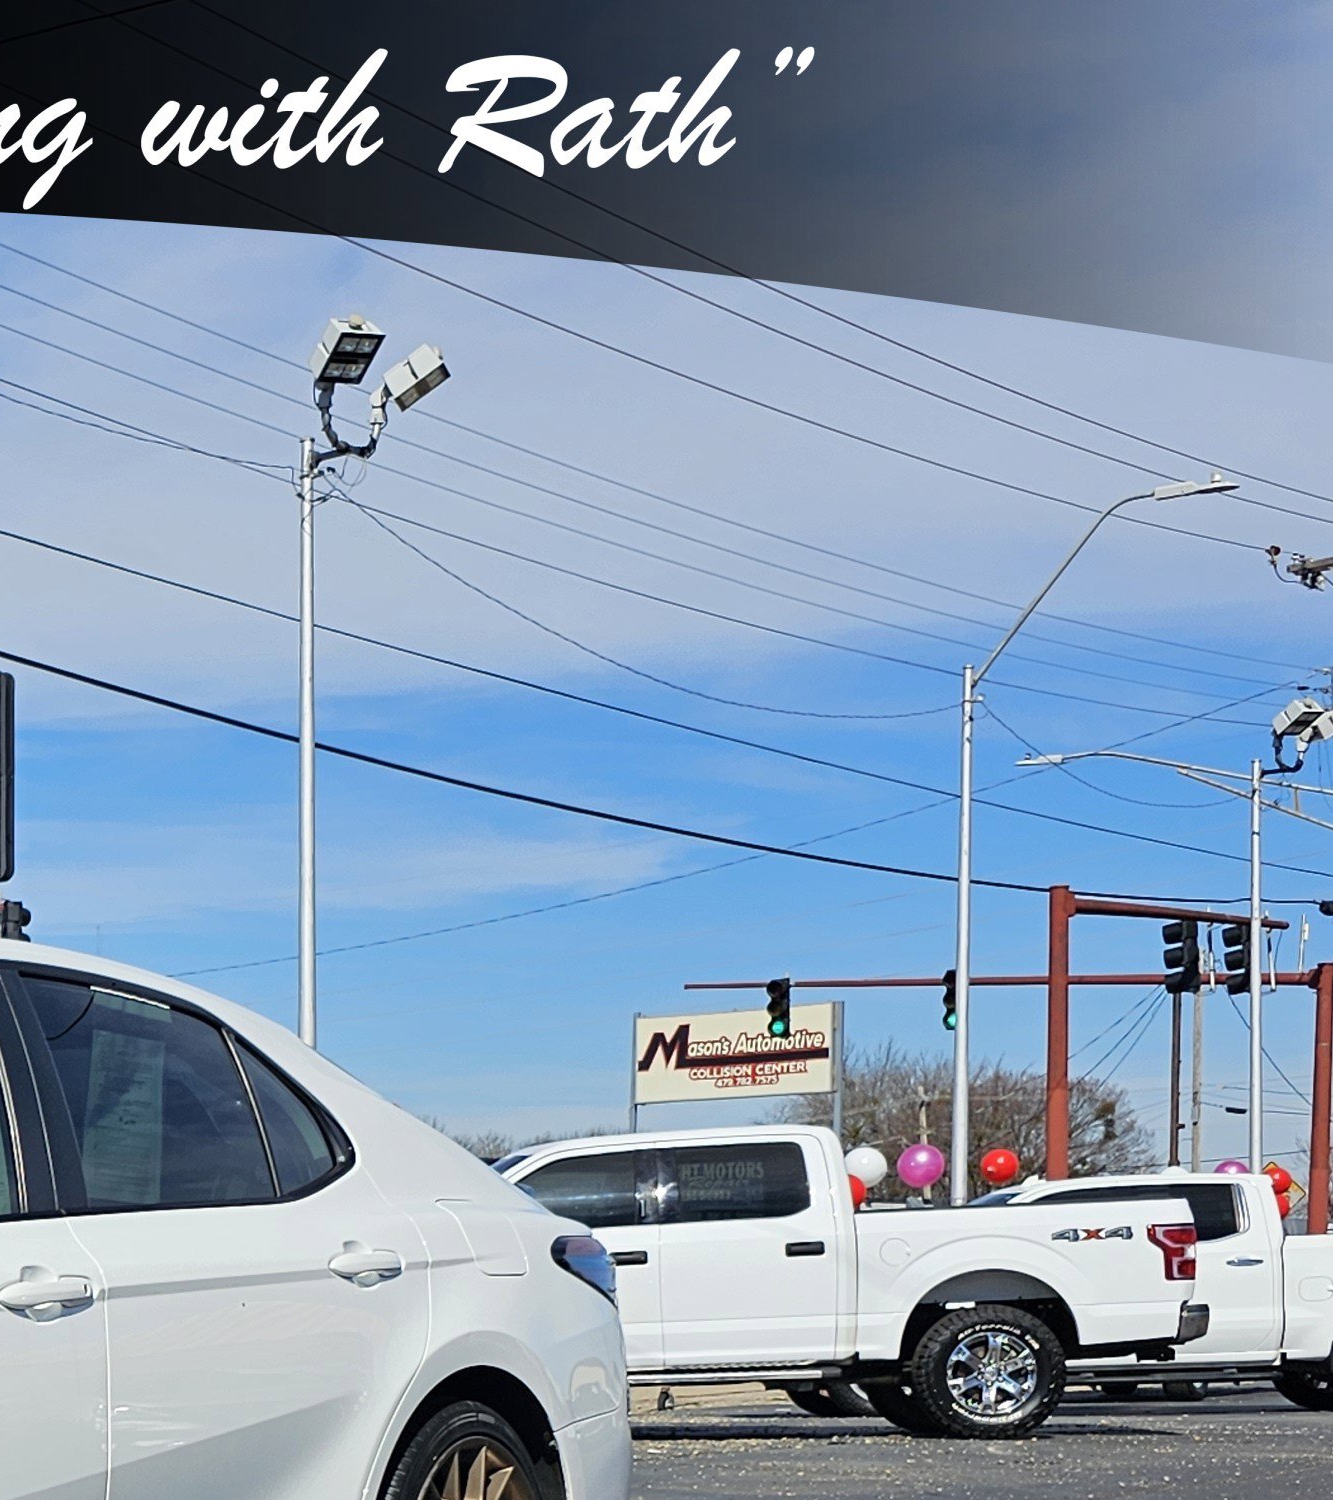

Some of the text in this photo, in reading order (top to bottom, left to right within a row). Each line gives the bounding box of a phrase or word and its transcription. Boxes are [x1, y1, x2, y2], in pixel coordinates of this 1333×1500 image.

[637, 1023, 825, 1072] Mason's Automotive
[690, 1061, 806, 1079] COLLISION CENTER
